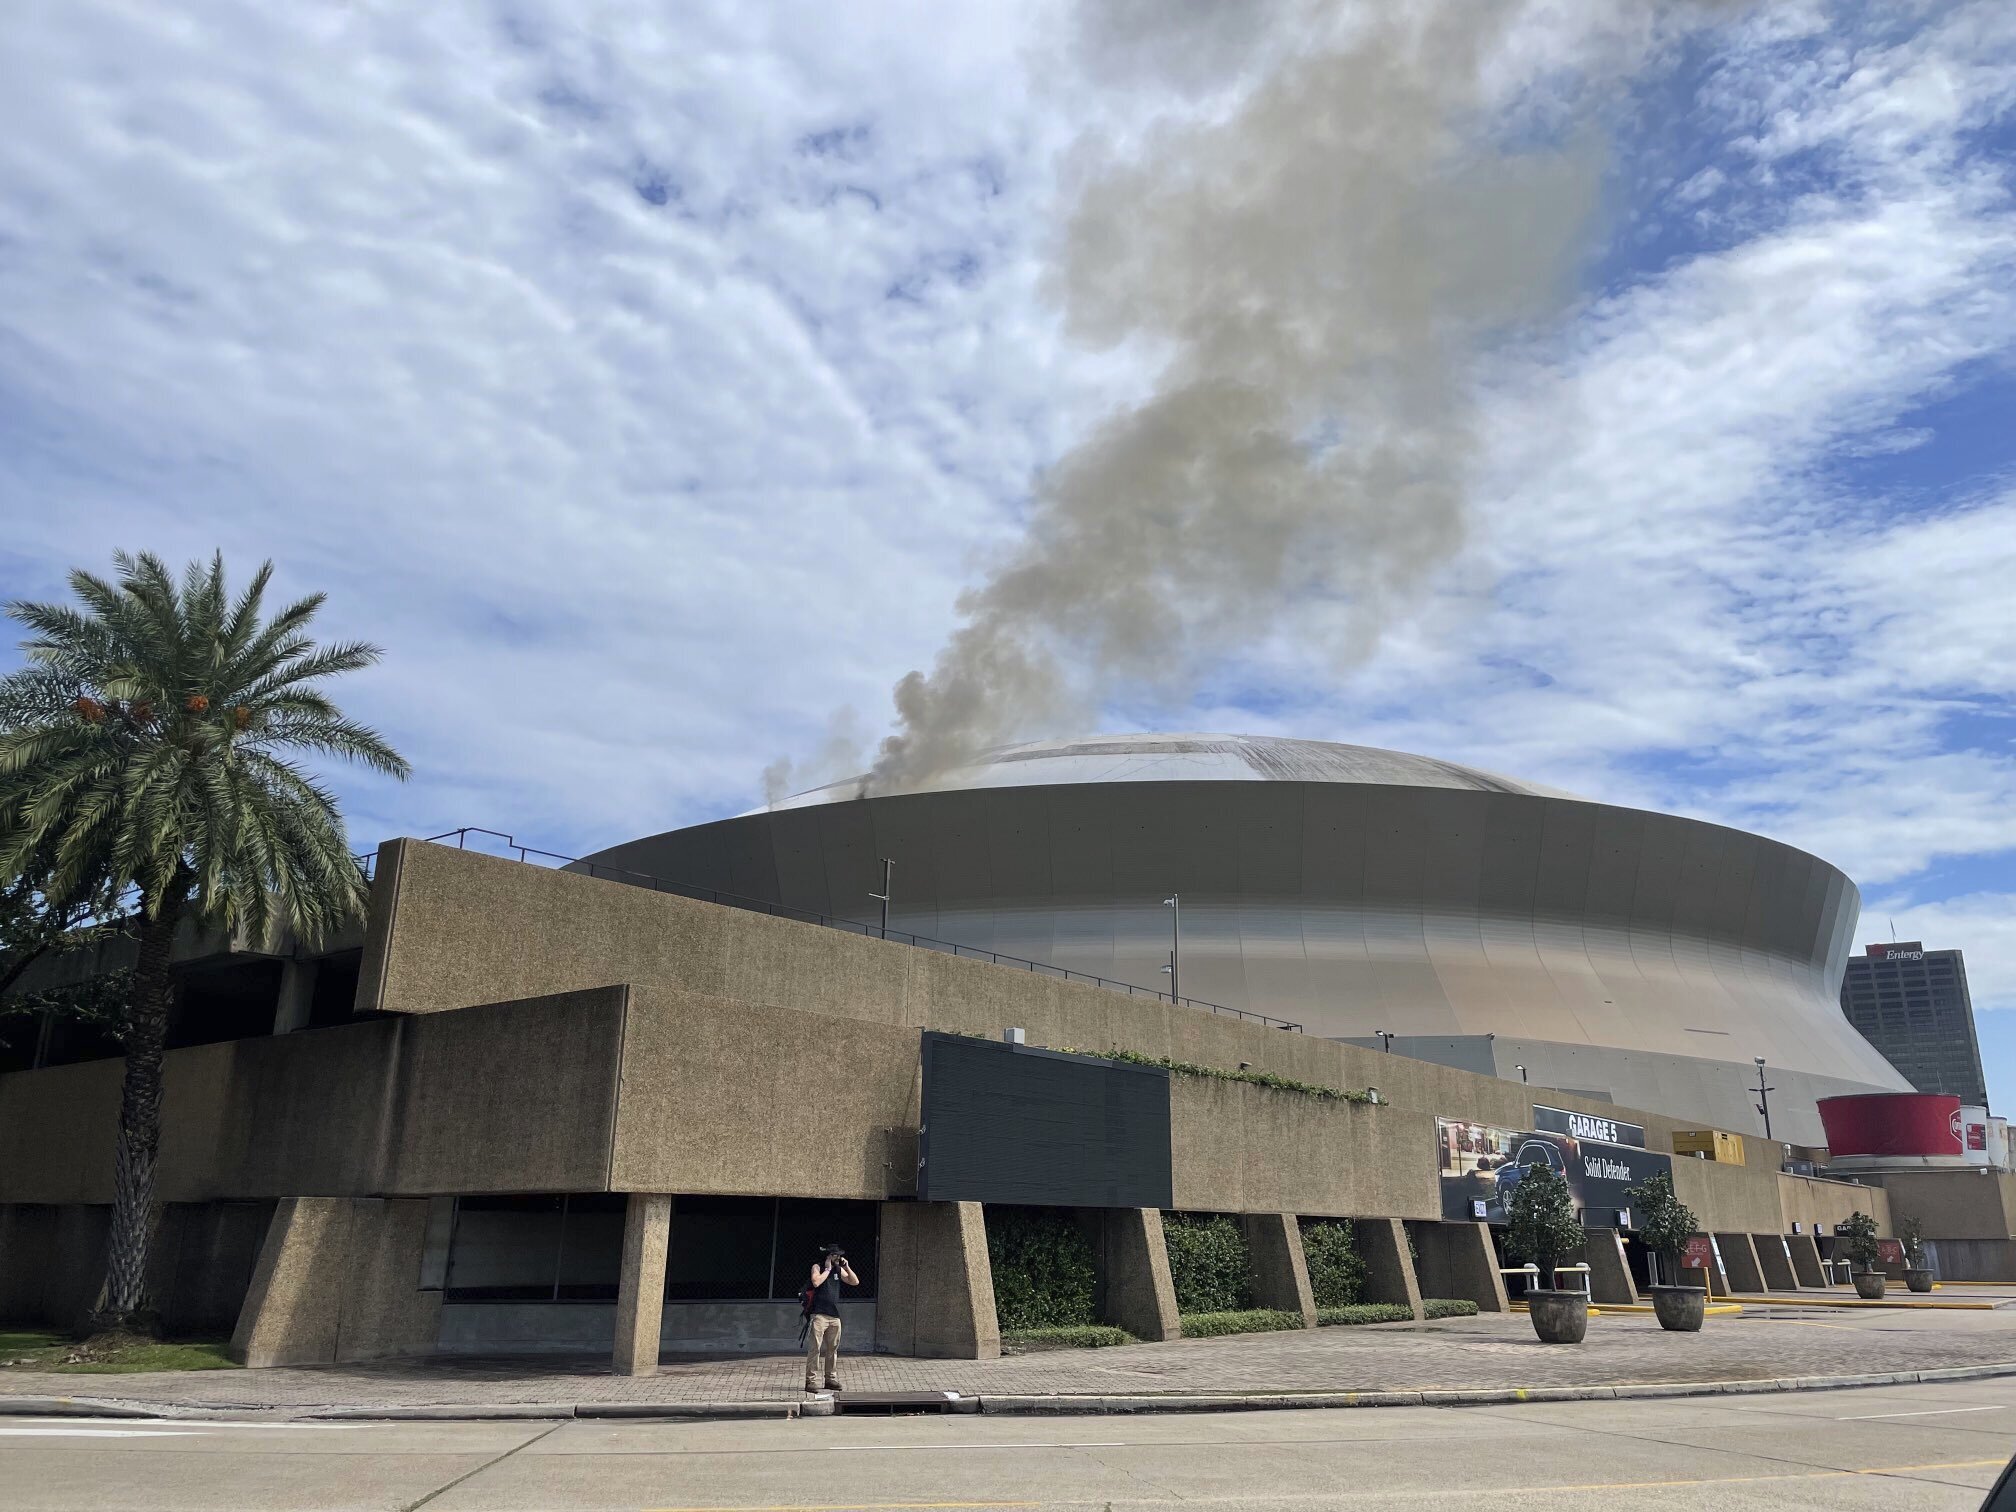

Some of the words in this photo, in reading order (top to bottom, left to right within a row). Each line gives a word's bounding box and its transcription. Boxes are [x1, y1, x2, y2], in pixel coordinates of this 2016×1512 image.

[1887, 950, 1924, 960] Entergy
[1569, 1115, 1609, 1141] GARAGE
[1611, 1124, 1617, 1142] 5
[1585, 1156, 1602, 1178] Solid
[1602, 1158, 1632, 1181] Defender.
